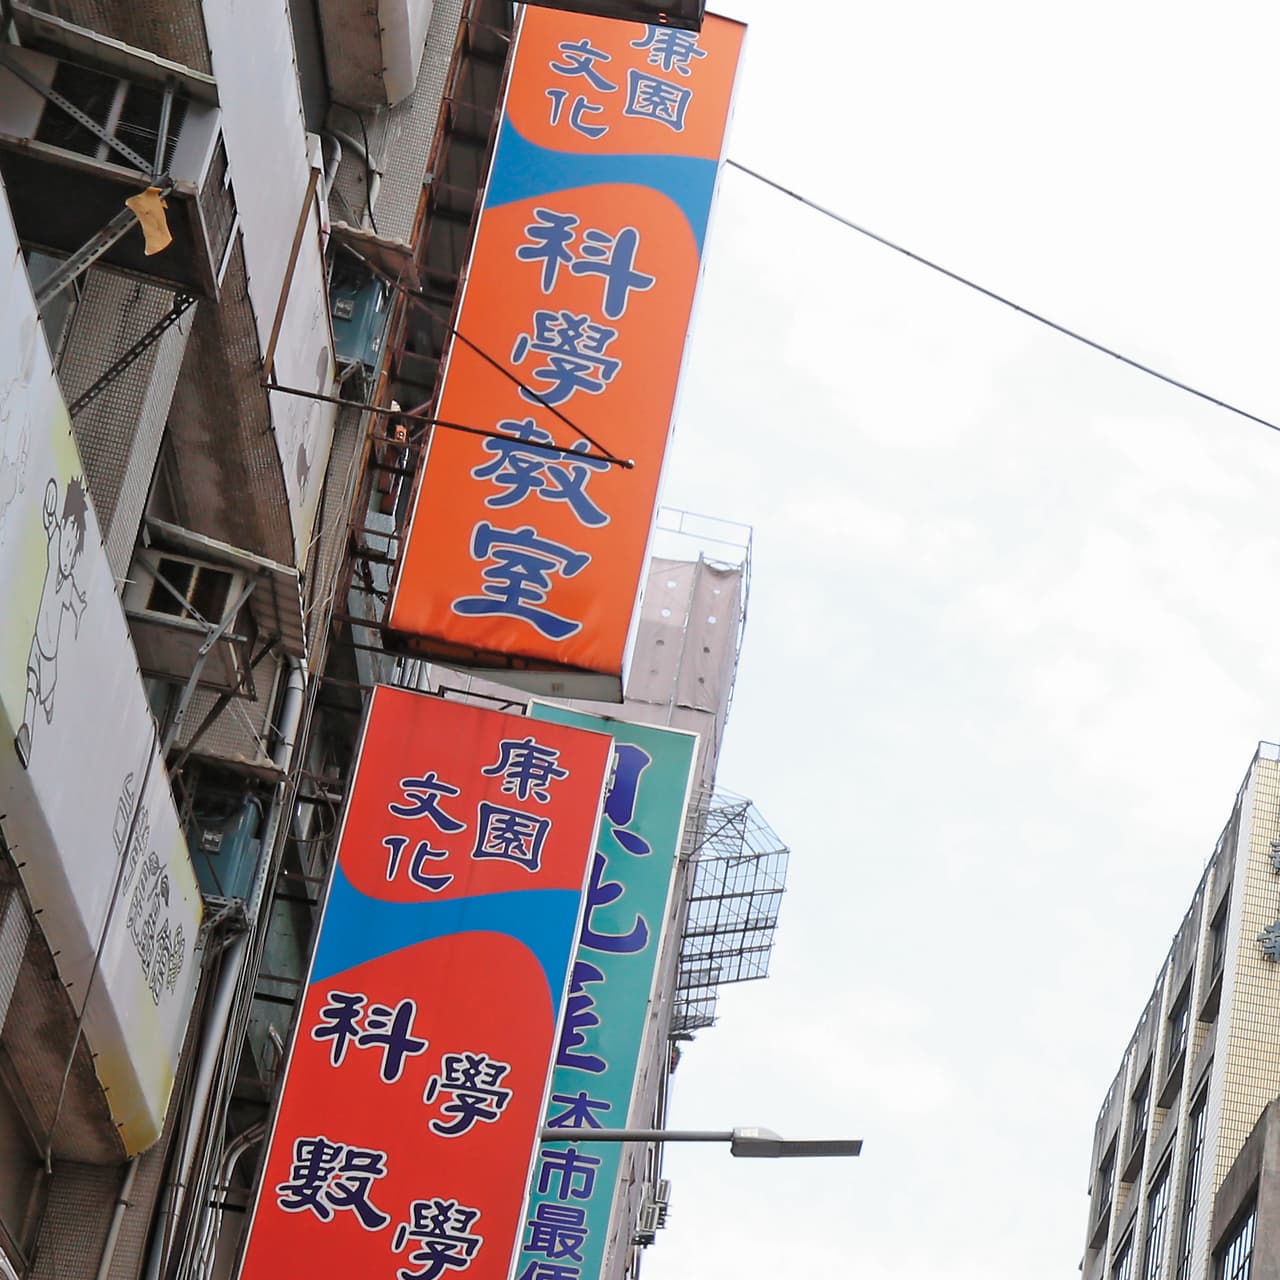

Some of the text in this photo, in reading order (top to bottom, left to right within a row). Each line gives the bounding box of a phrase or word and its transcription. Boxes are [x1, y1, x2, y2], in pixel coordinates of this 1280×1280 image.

[546, 39, 617, 139] 文化
[450, 206, 656, 641] 科學教室
[385, 772, 467, 891] 文化
[473, 738, 568, 871] 康園
